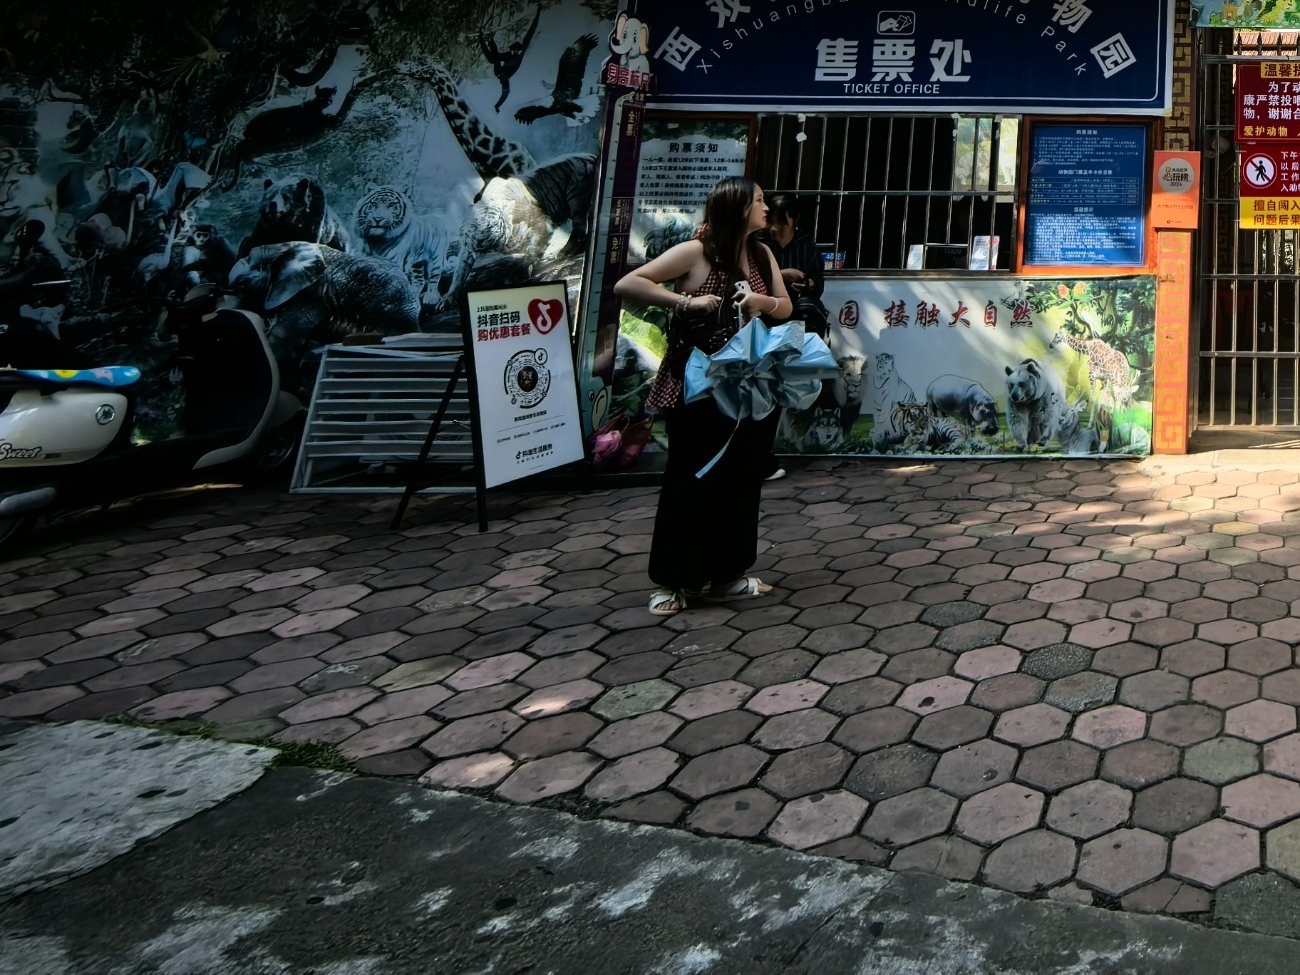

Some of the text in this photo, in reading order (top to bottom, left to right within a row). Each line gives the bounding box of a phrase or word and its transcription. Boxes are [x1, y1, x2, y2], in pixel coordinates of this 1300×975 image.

[814, 38, 972, 82] 售票处
[1041, 26, 1087, 76] Park
[843, 83, 940, 94] TICKET OFFICE
[1243, 126, 1288, 137] 爱护动物
[669, 142, 719, 154] 购票须知
[477, 311, 521, 328] 抖音扫码
[884, 300, 1034, 329] 接触大自然
[477, 323, 531, 342] 购优惠套餐
[0, 443, 42, 461] Sweet
